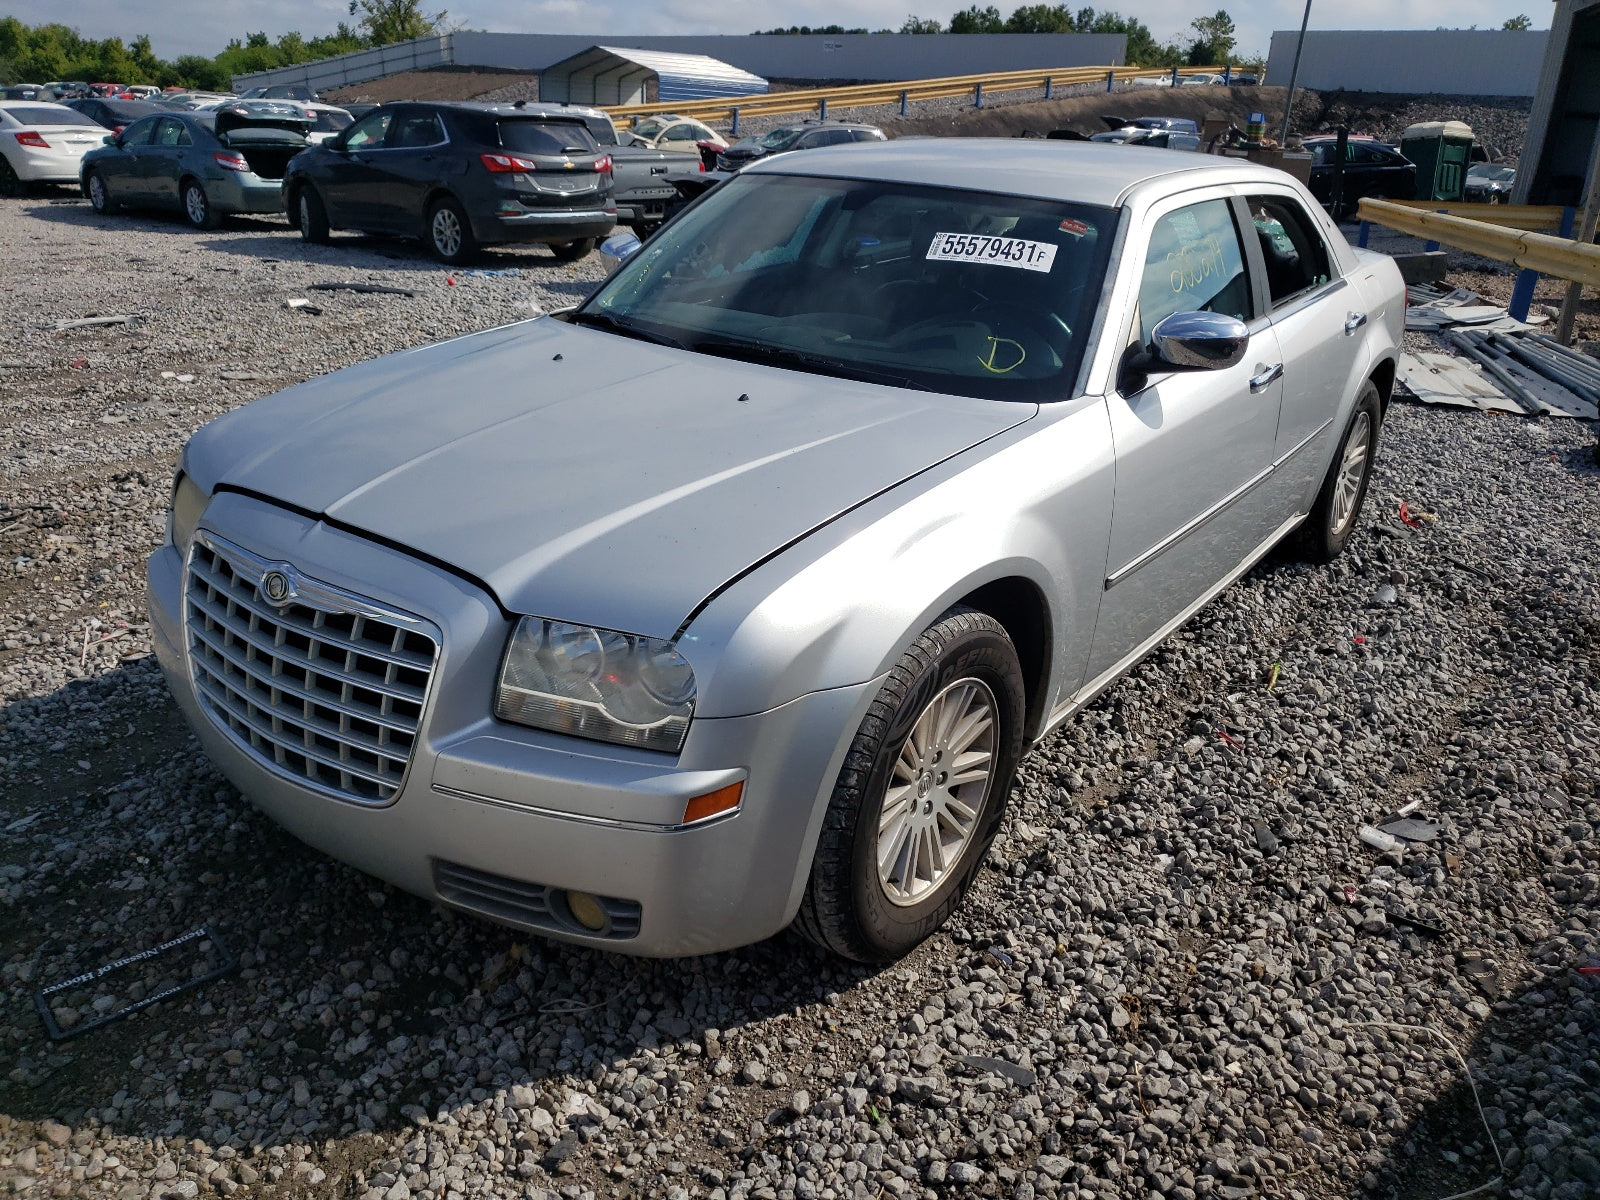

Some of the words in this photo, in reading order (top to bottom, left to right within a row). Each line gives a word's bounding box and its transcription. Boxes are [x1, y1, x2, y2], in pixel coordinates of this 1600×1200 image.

[942, 235, 1037, 263] 55579431
[1037, 251, 1046, 262] F
[160, 928, 206, 950] Benton
[114, 947, 160, 968] Nissan
[97, 966, 112, 977] of
[41, 971, 96, 996] Hoover
